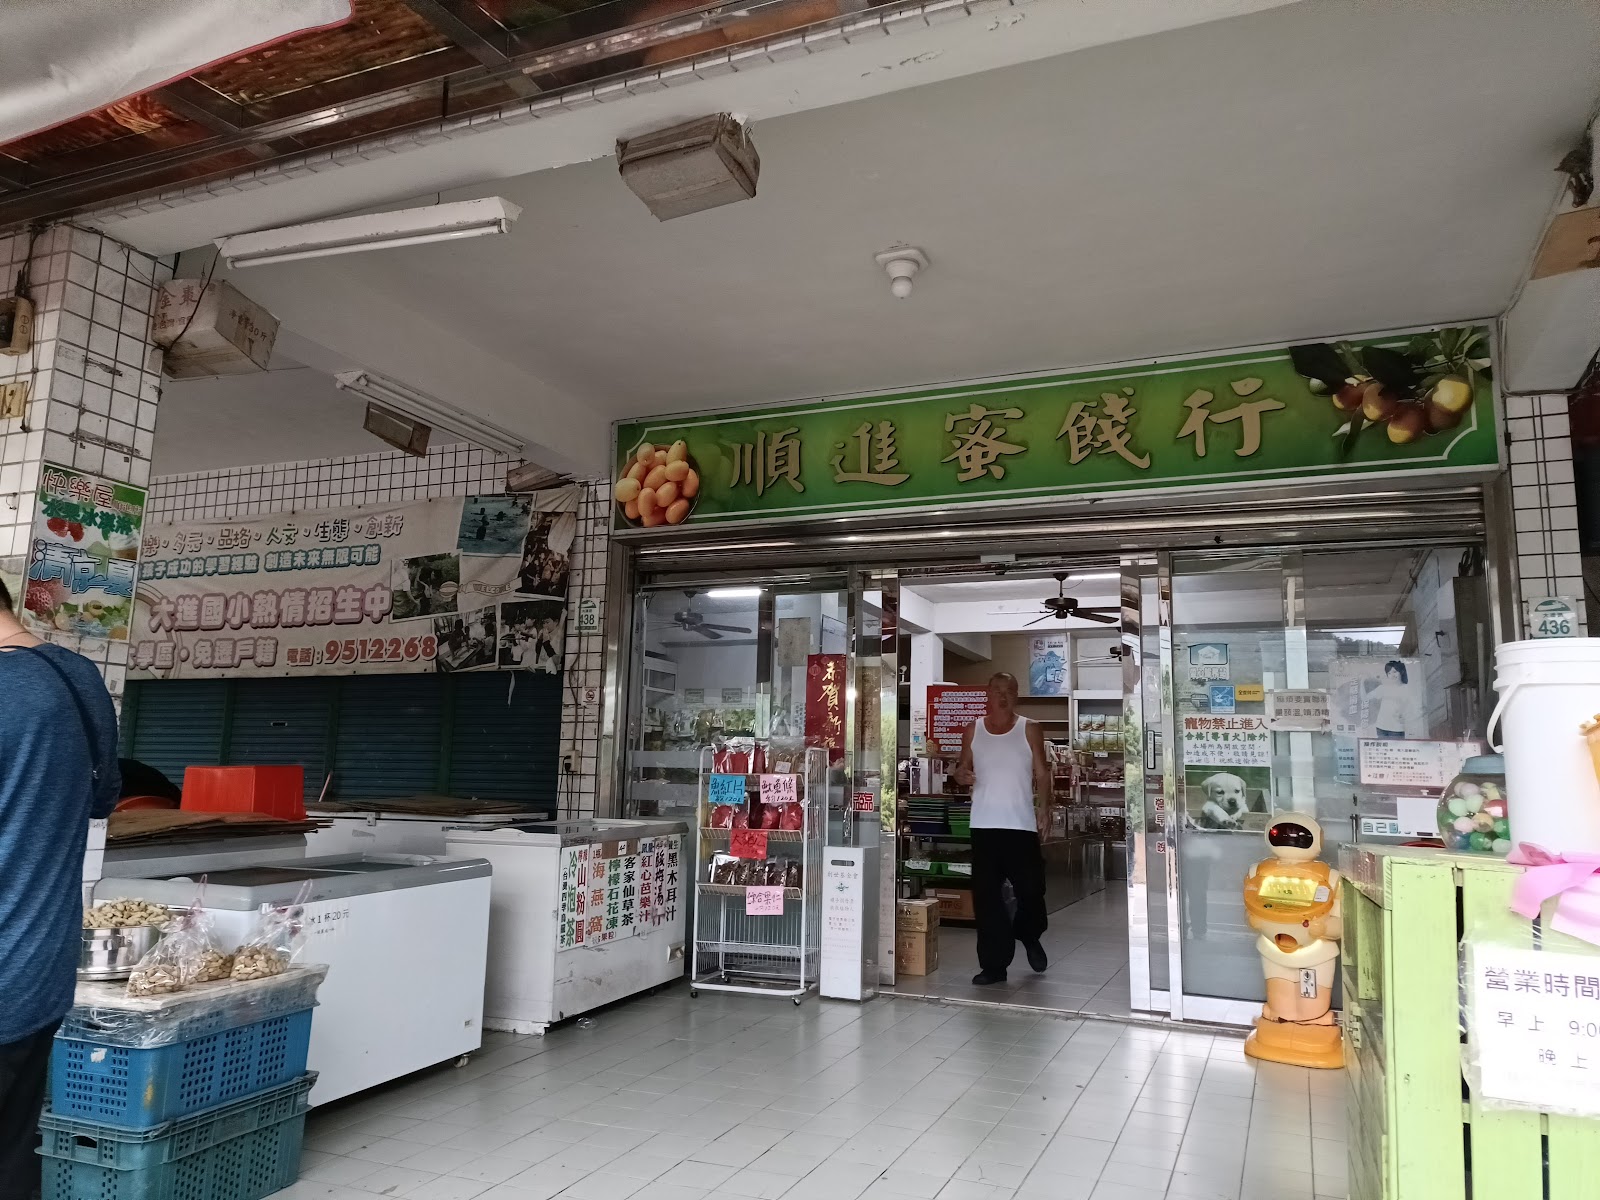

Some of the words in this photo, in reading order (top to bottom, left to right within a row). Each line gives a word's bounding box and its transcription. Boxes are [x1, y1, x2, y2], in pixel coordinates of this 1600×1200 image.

[730, 377, 1286, 497] 順進蜜餞行
[43, 469, 114, 509] 快樂屋
[42, 498, 133, 535] 水果冰淇淋
[264, 544, 381, 572] 創造未來無限可能
[150, 583, 393, 633] 大進國小熱情招生中
[473, 583, 511, 594] WELCOME
[1538, 620, 1571, 635] 436
[1184, 717, 1269, 730] 寵物禁止進入
[565, 851, 578, 948] 冷泡茶
[575, 863, 587, 944] 山粉圓
[589, 861, 606, 933] 海燕窩
[621, 856, 636, 927] 客家仙草茶
[639, 855, 653, 923] 紅心芭樂汁
[666, 852, 679, 922] 黑木耳汁
[1485, 966, 1600, 1001] 營業時間
[1569, 1020, 1600, 1038] 9:0
